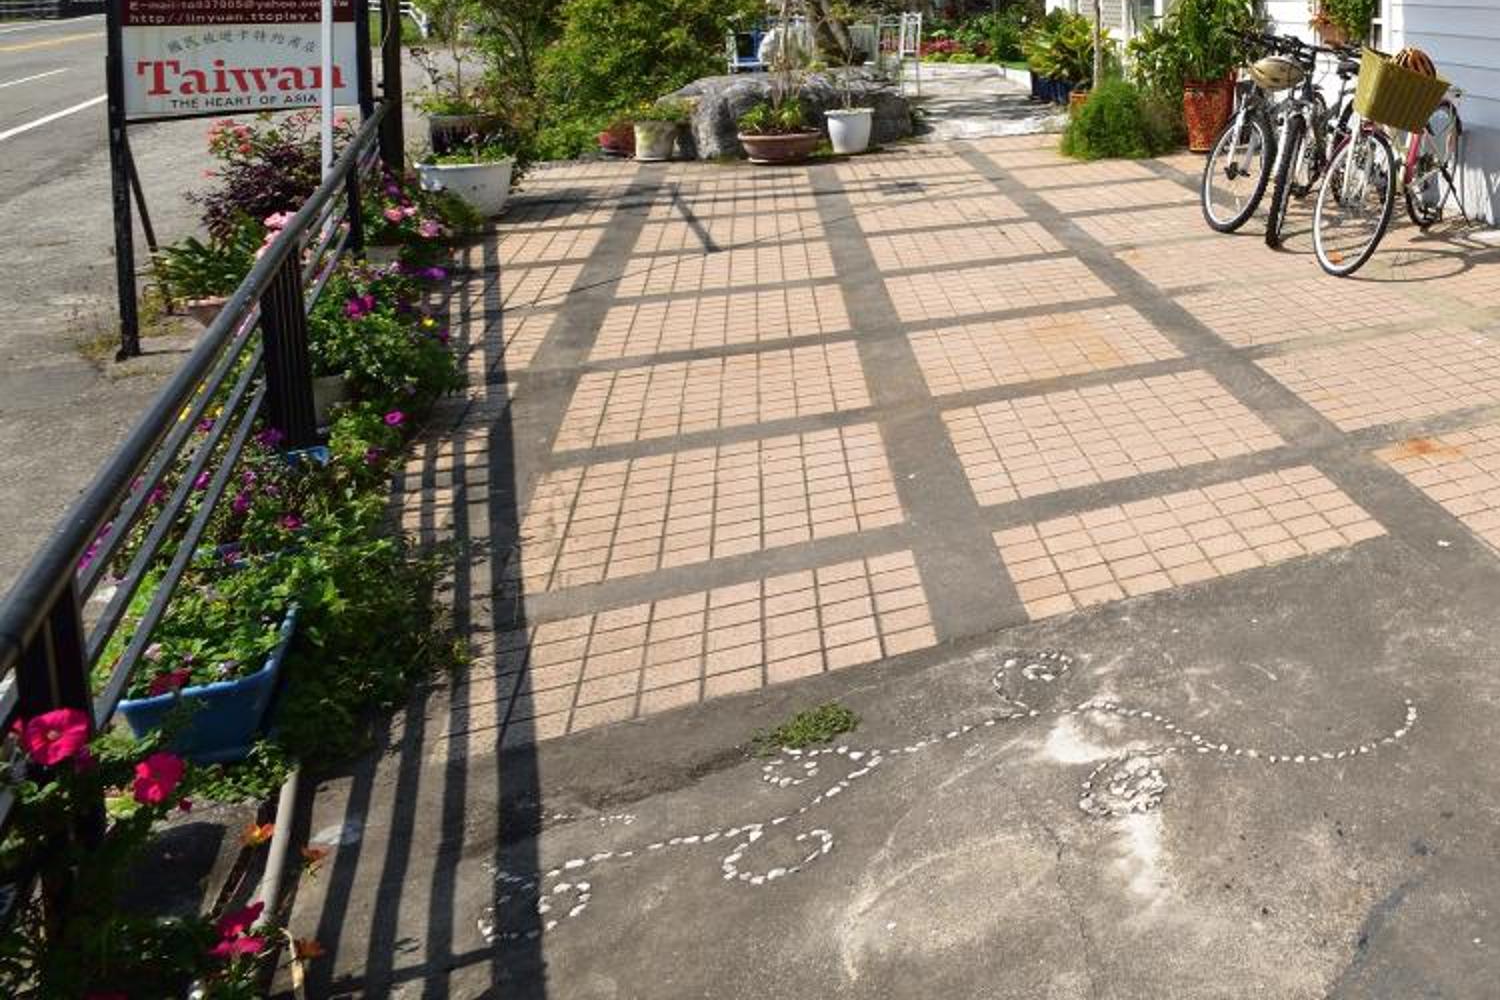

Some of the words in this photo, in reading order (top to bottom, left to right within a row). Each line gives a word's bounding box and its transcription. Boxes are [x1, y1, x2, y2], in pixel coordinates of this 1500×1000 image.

[136, 59, 347, 96] Taiwan
[171, 99, 199, 109] THE
[205, 96, 251, 107] HEART
[260, 96, 277, 105] OF
[284, 94, 317, 104] ASIA
